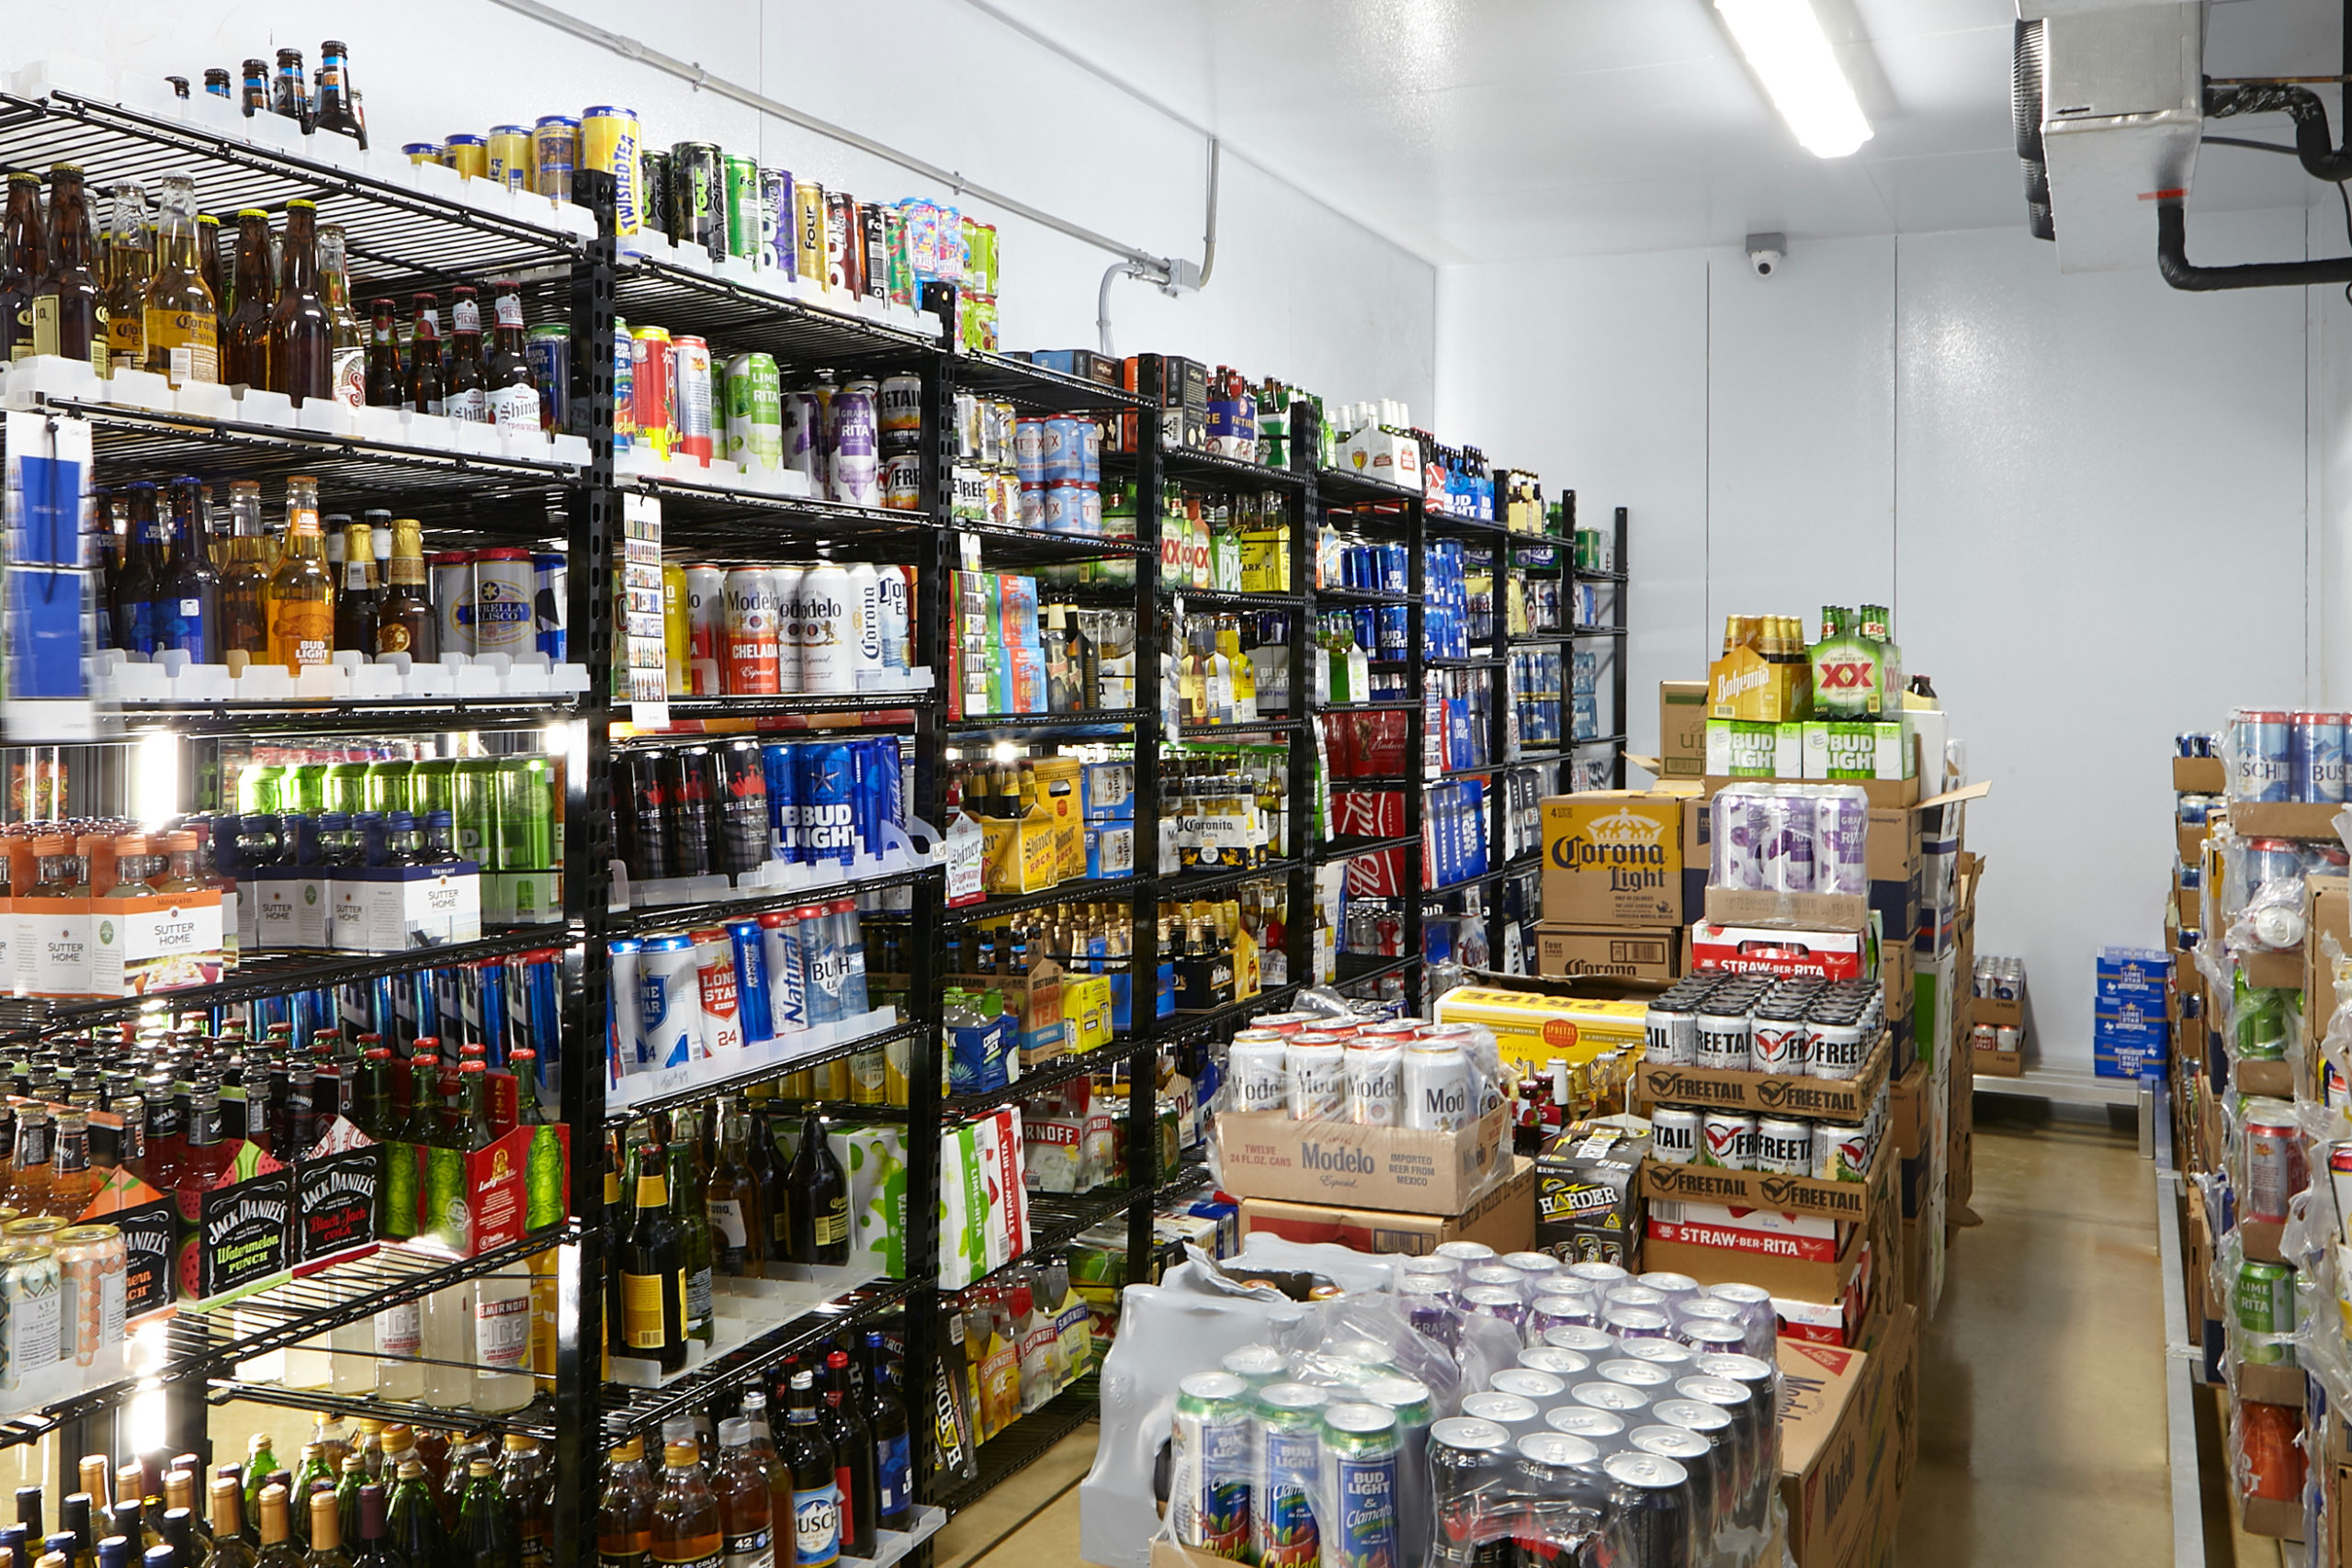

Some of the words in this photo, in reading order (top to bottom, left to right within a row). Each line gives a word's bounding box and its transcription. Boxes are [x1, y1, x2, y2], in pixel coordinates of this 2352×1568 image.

[752, 372, 778, 385] LIME
[753, 390, 779, 404] RITA
[841, 410, 870, 420] GRAPE
[842, 424, 871, 437] RITA
[1219, 558, 1242, 592] IPA
[802, 599, 842, 618] odelo
[861, 586, 876, 660] Corona
[300, 640, 325, 650] BUD
[732, 643, 779, 660] CHELADA
[295, 649, 329, 660] LIGHT
[1260, 667, 1287, 677] BUD
[1820, 662, 1875, 689] XX
[1715, 663, 1770, 704] Bohemia
[1257, 690, 1288, 698] PLATINU
[1732, 732, 1775, 751] BUD
[1829, 732, 1874, 751] BUD
[1184, 818, 1233, 833] Coronita
[1025, 831, 1053, 861] Shiner
[1552, 834, 1667, 873] Corona
[1029, 852, 1052, 874] BOCK
[431, 867, 456, 875] MERLOT
[1608, 865, 1667, 893] Light
[156, 897, 193, 907] MOSCATO
[428, 889, 459, 901] SUTTER
[432, 897, 456, 908] HOME
[263, 903, 292, 913] SUTTER
[266, 911, 290, 920] HOME
[335, 904, 362, 915] SUTTER
[338, 912, 359, 921] HOME
[154, 922, 195, 936] SUTTER
[159, 933, 191, 944] HOME
[1544, 941, 1563, 950] four
[48, 942, 84, 953] SUTTER
[51, 953, 80, 963] HOME
[1565, 958, 1636, 976] Corona
[1721, 959, 1826, 977] STRAW-BER-RITA
[784, 932, 806, 1025] Natural
[1033, 1006, 1061, 1028] TEA
[718, 1031, 738, 1047] 24
[1501, 1044, 1529, 1053] ENJOY
[1676, 1077, 1746, 1101] FREETAIL
[1786, 1089, 1858, 1111] FREETAIL
[1244, 1145, 1276, 1156] TWELVE
[1301, 1142, 1375, 1174] Modelo
[1230, 1153, 1240, 1163] 24
[1269, 1156, 1292, 1168] CANS
[1389, 1153, 1432, 1166] IMPORTED
[1388, 1164, 1410, 1175] BEER
[1413, 1167, 1435, 1177] FROM
[1318, 1174, 1358, 1189] Especial
[1396, 1175, 1428, 1187] MEXICO
[1678, 1172, 1748, 1196] FREETAIL
[301, 1181, 333, 1213] JACK
[330, 1170, 378, 1198] DANIEL'S
[1791, 1185, 1862, 1211] FREETAIL
[1539, 1185, 1619, 1215] HARDER
[209, 1210, 242, 1246] JACK
[239, 1199, 288, 1226] DANIEL'S
[323, 1225, 352, 1241] COLA
[217, 1234, 279, 1264] Watermelon
[1680, 1226, 1800, 1257] STRAW-BER-RITA
[228, 1252, 268, 1274] PUNCH
[2241, 1280, 2269, 1295] LIME
[479, 1296, 529, 1318] SMIRNOFF
[2241, 1296, 2270, 1314] RITA
[489, 1320, 526, 1345] ICE
[1281, 1445, 1312, 1459] BUD
[1274, 1456, 1317, 1469] LIGHT
[1458, 1456, 1476, 1468] 25
[1353, 1472, 1385, 1485] BUD
[1348, 1482, 1390, 1495] LIGHT
[1363, 1497, 1376, 1508] &
[1346, 1506, 1394, 1529] Clamato
[735, 1537, 752, 1550] 42
